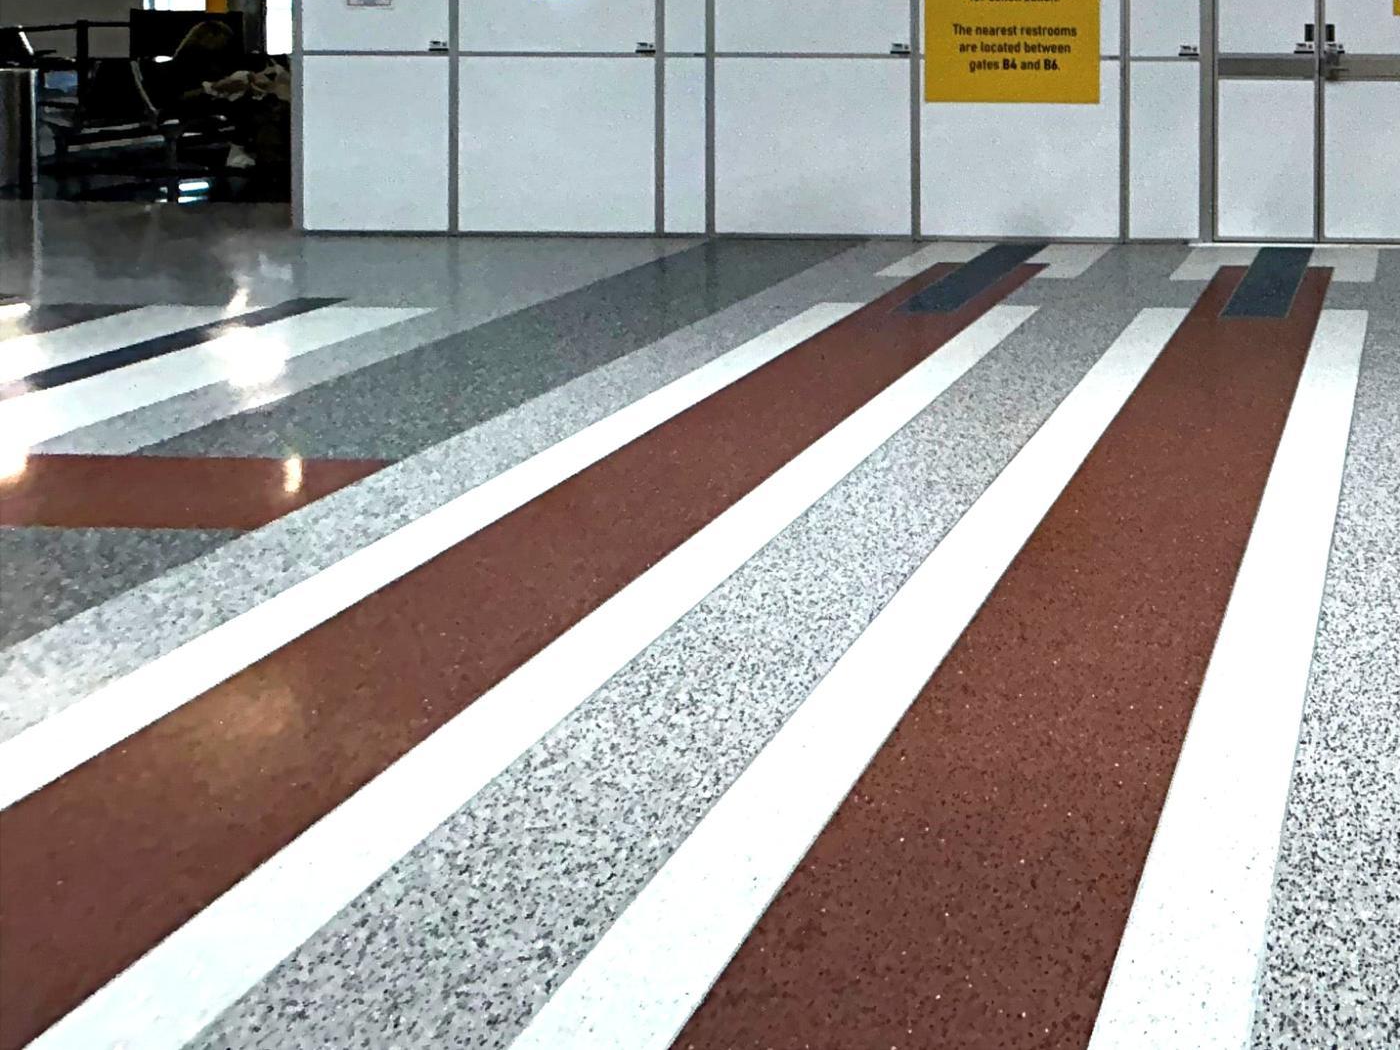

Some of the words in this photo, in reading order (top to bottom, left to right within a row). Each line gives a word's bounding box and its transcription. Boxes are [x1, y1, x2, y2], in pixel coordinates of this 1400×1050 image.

[952, 23, 973, 36] The
[975, 25, 1017, 36] nearest
[1020, 25, 1077, 36] restrooms
[959, 44, 978, 53] are
[980, 41, 1021, 53] located
[1024, 41, 1071, 53] between
[969, 60, 1000, 72] gates
[1002, 58, 1017, 70] B4
[1020, 58, 1041, 70] and
